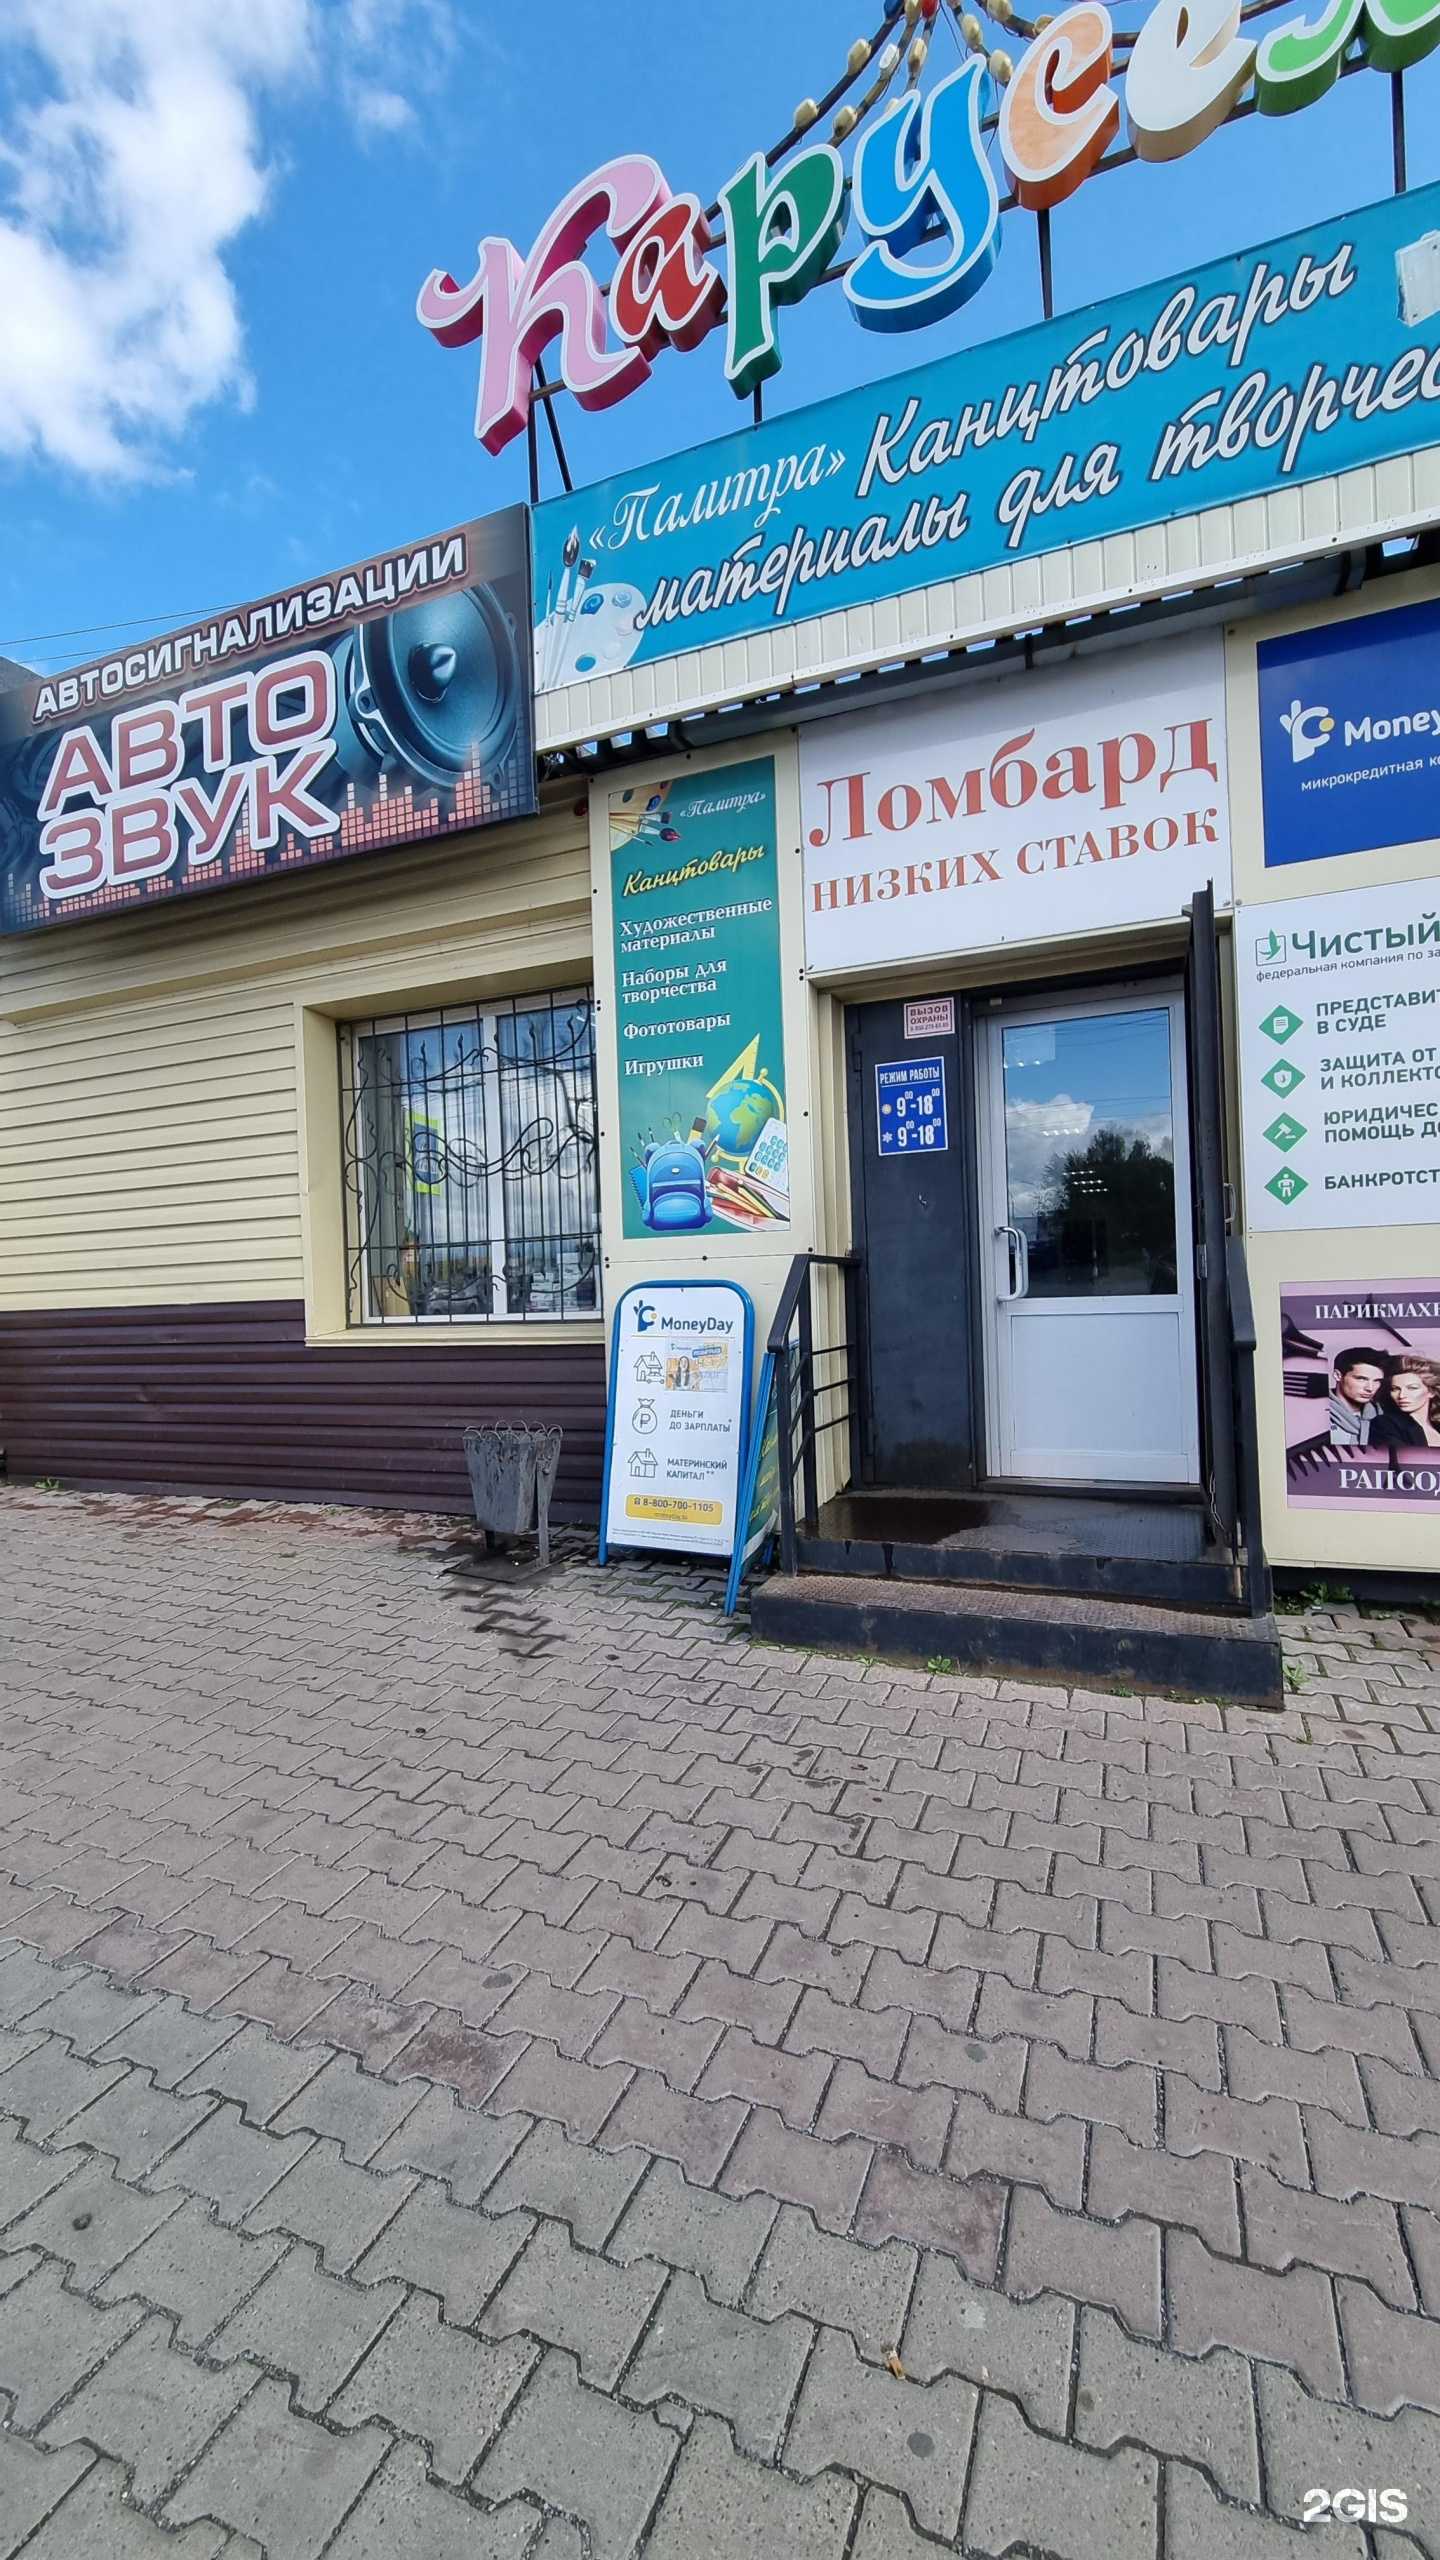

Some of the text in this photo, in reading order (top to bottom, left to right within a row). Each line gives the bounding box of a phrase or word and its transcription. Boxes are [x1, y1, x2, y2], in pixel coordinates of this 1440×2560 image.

[857, 245, 1355, 497] Канцтовары
[635, 493, 968, 630] материалы
[998, 442, 1120, 549] для
[33, 535, 466, 720] АВТОСИГНАЛИЗАЦИИ
[39, 653, 335, 819] АВТО
[809, 718, 1218, 847] Ломбард
[1301, 756, 1440, 791] микрокредитная к
[40, 741, 339, 898] ЗВУК
[623, 845, 765, 897] Канцтовары
[812, 808, 1219, 912] НИЗКИХ СТАВОК
[620, 898, 772, 937] Художественные
[621, 927, 716, 953] материалы
[1292, 911, 1440, 958] Чистый
[622, 959, 727, 987] Наборы для
[1256, 961, 1337, 982] федеральная
[1341, 953, 1404, 970] компания
[1408, 951, 1423, 961] по
[623, 979, 717, 1004] творчества
[911, 1005, 948, 1016] ВЫЗОВ
[911, 1014, 948, 1025] ОХРАНЫ
[623, 1014, 731, 1039] Фототовары
[1317, 1014, 1386, 1034] В СУДЕ
[624, 1055, 704, 1076] Игрушки
[1320, 1047, 1437, 1072] ЗАЩИТА ОТ
[880, 1066, 940, 1084] РЕЖИМ РАБОТЫ
[1321, 1076, 1334, 1090] И
[1324, 1103, 1438, 1125] ЮРИДИЧЕС
[1325, 1120, 1440, 1142] ПОМОЩЬ Д
[1325, 1169, 1440, 1190] БАНКРОТСТ
[661, 1317, 734, 1334] MoneyDay
[669, 1409, 704, 1419] ДЕНЬГИ
[669, 1421, 682, 1430] ДО
[667, 1457, 728, 1470] МАТЕРИНСКИЙ
[643, 1497, 714, 1512] 8-800-700-1105
